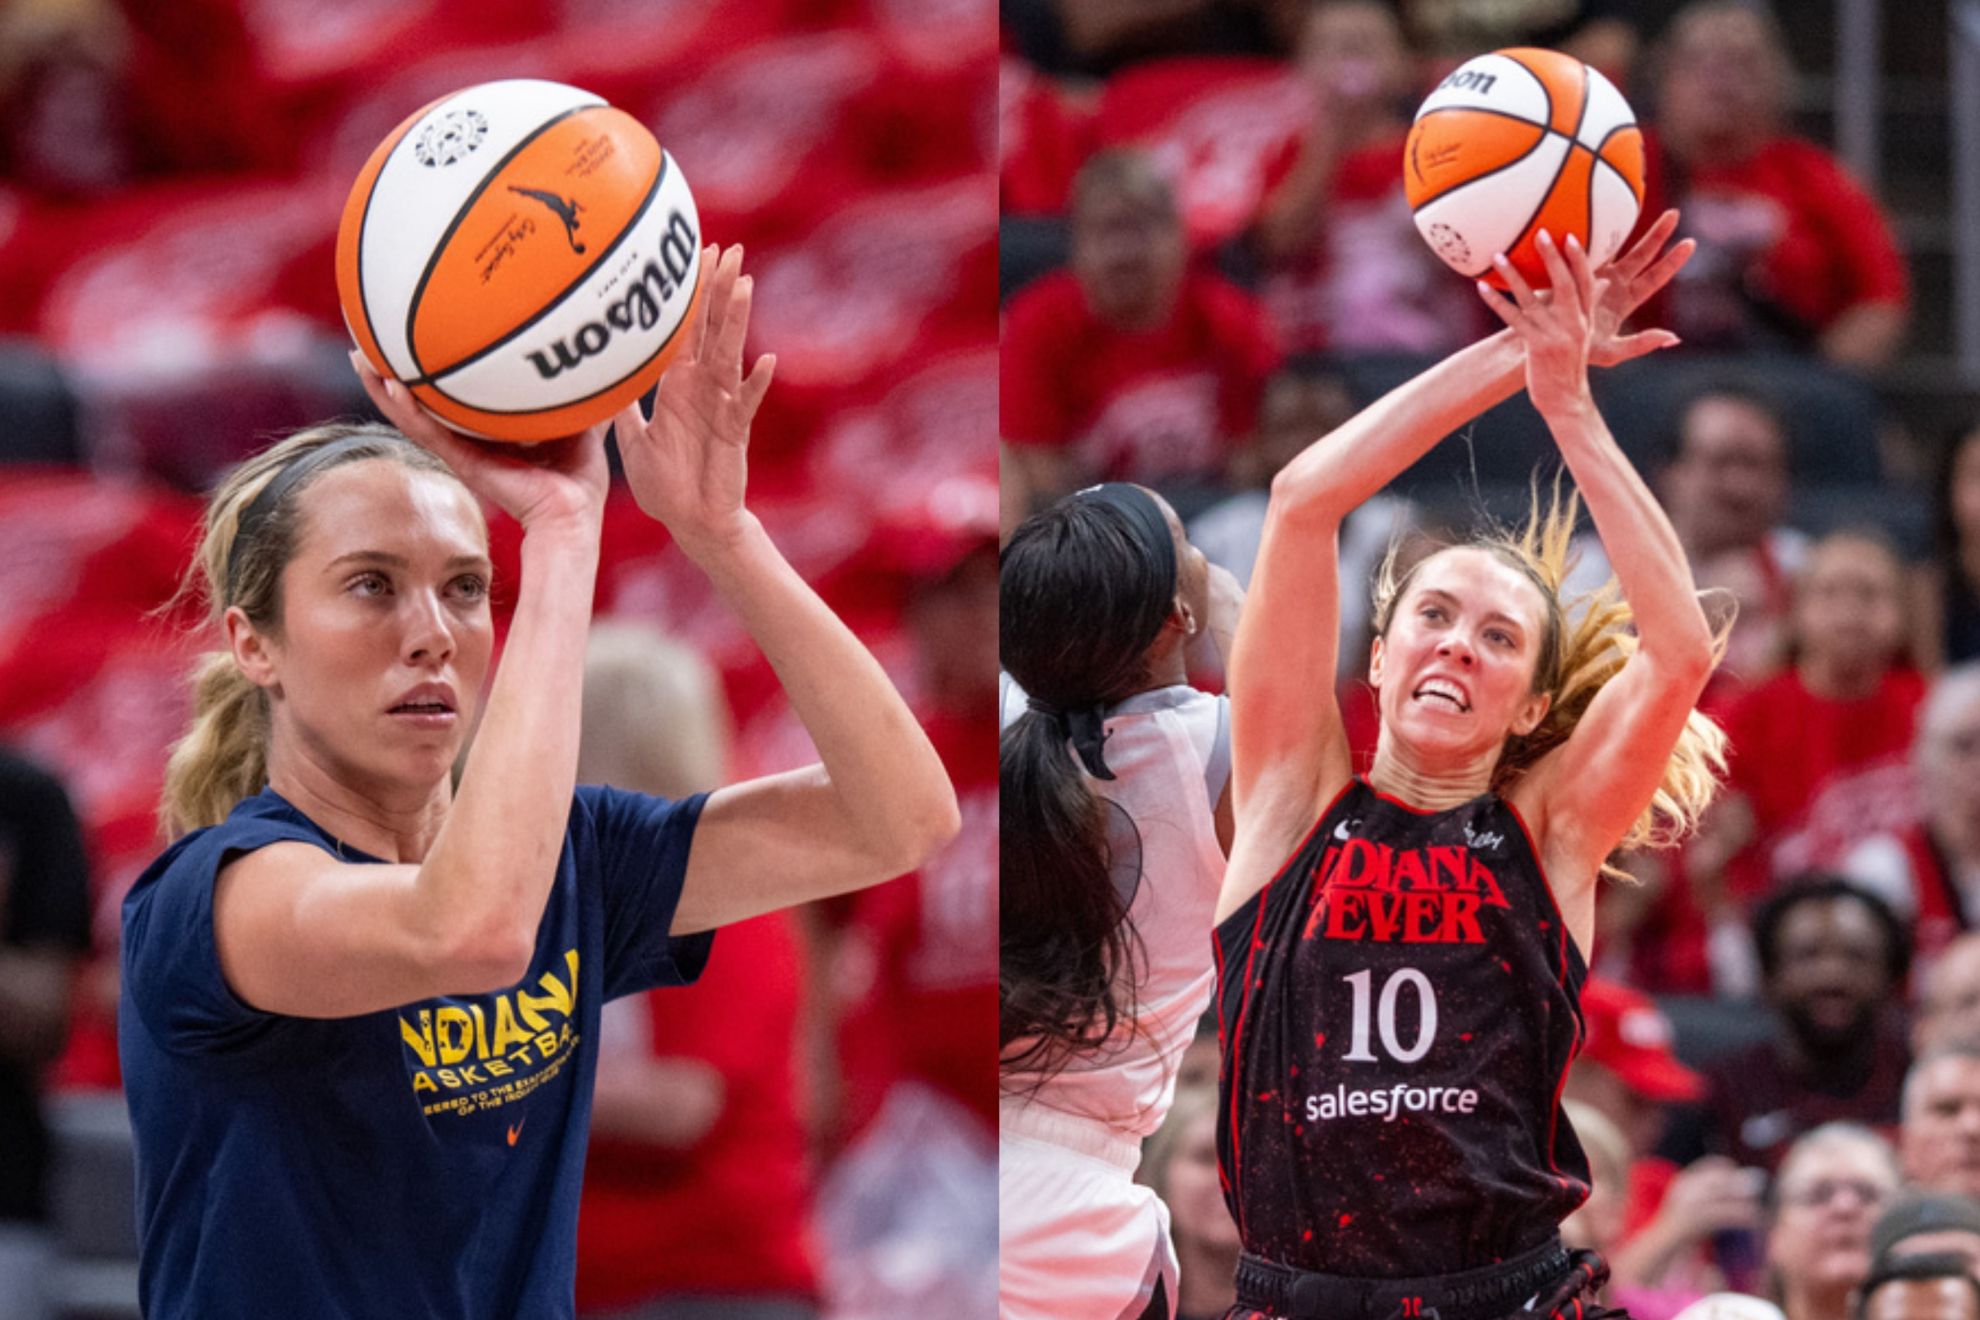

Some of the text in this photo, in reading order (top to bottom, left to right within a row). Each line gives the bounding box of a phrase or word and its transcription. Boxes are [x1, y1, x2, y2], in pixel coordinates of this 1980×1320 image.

[1440, 69, 1497, 95] on
[525, 207, 697, 380] Wilson
[1341, 967, 1438, 1064] 10
[456, 1102, 476, 1117] OF
[479, 1096, 502, 1111] THE
[470, 1090, 489, 1102] TO
[489, 1082, 513, 1098] THE
[1306, 1084, 1479, 1122] salesforce
